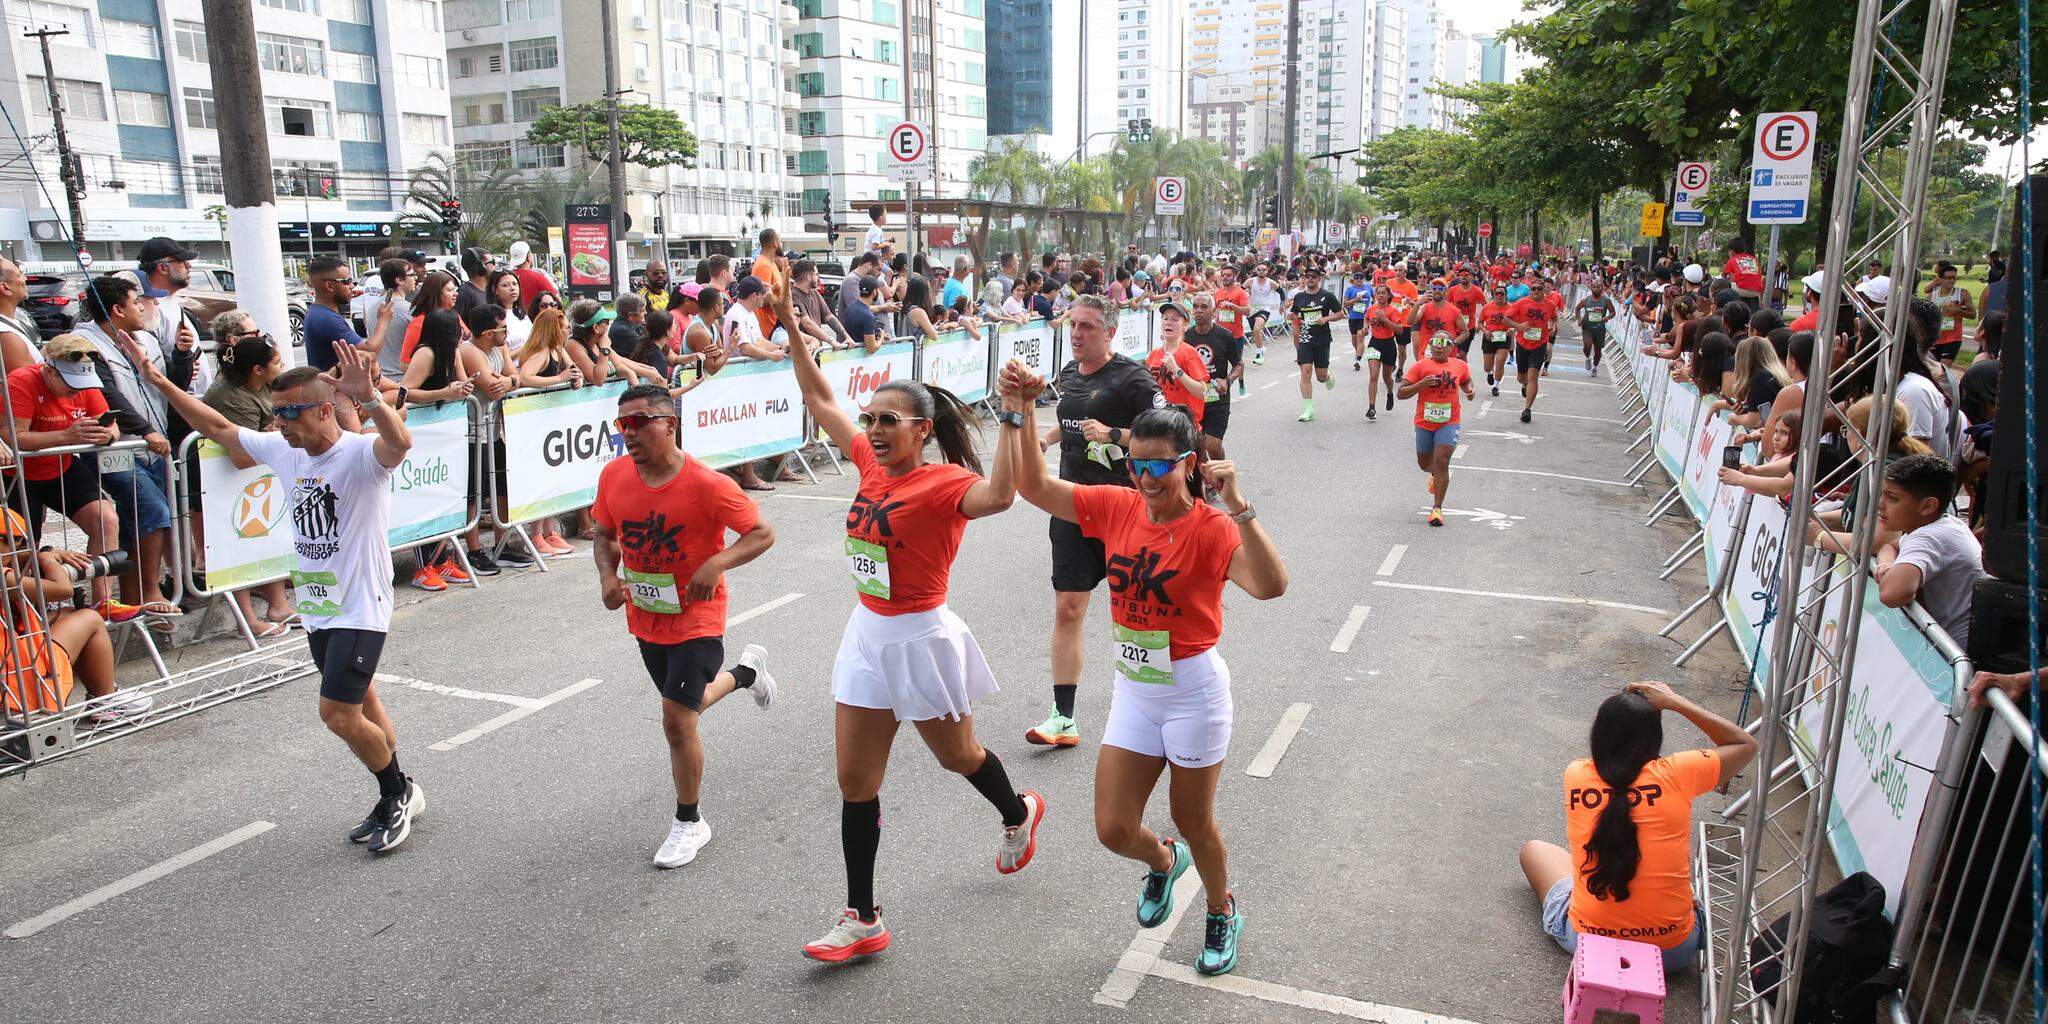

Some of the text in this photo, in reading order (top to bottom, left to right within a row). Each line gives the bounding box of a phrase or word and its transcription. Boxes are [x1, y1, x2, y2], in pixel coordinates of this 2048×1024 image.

[900, 131, 913, 153] E
[1775, 125, 1794, 151] E
[1688, 169, 1699, 184] E
[1166, 184, 1175, 197] E
[1013, 338, 1040, 355] POWER
[1026, 352, 1040, 368] ADE
[847, 362, 891, 400] ifood
[710, 398, 789, 425] KALLAN FILA
[401, 456, 449, 491] Saúde
[852, 556, 876, 575] 1258
[307, 585, 328, 597] 1126
[635, 584, 661, 598] 2321
[1126, 613, 1149, 626] 2025
[1121, 643, 1150, 664] 2212
[1853, 684, 1877, 769] Costa
[1871, 721, 1908, 820] Saúde
